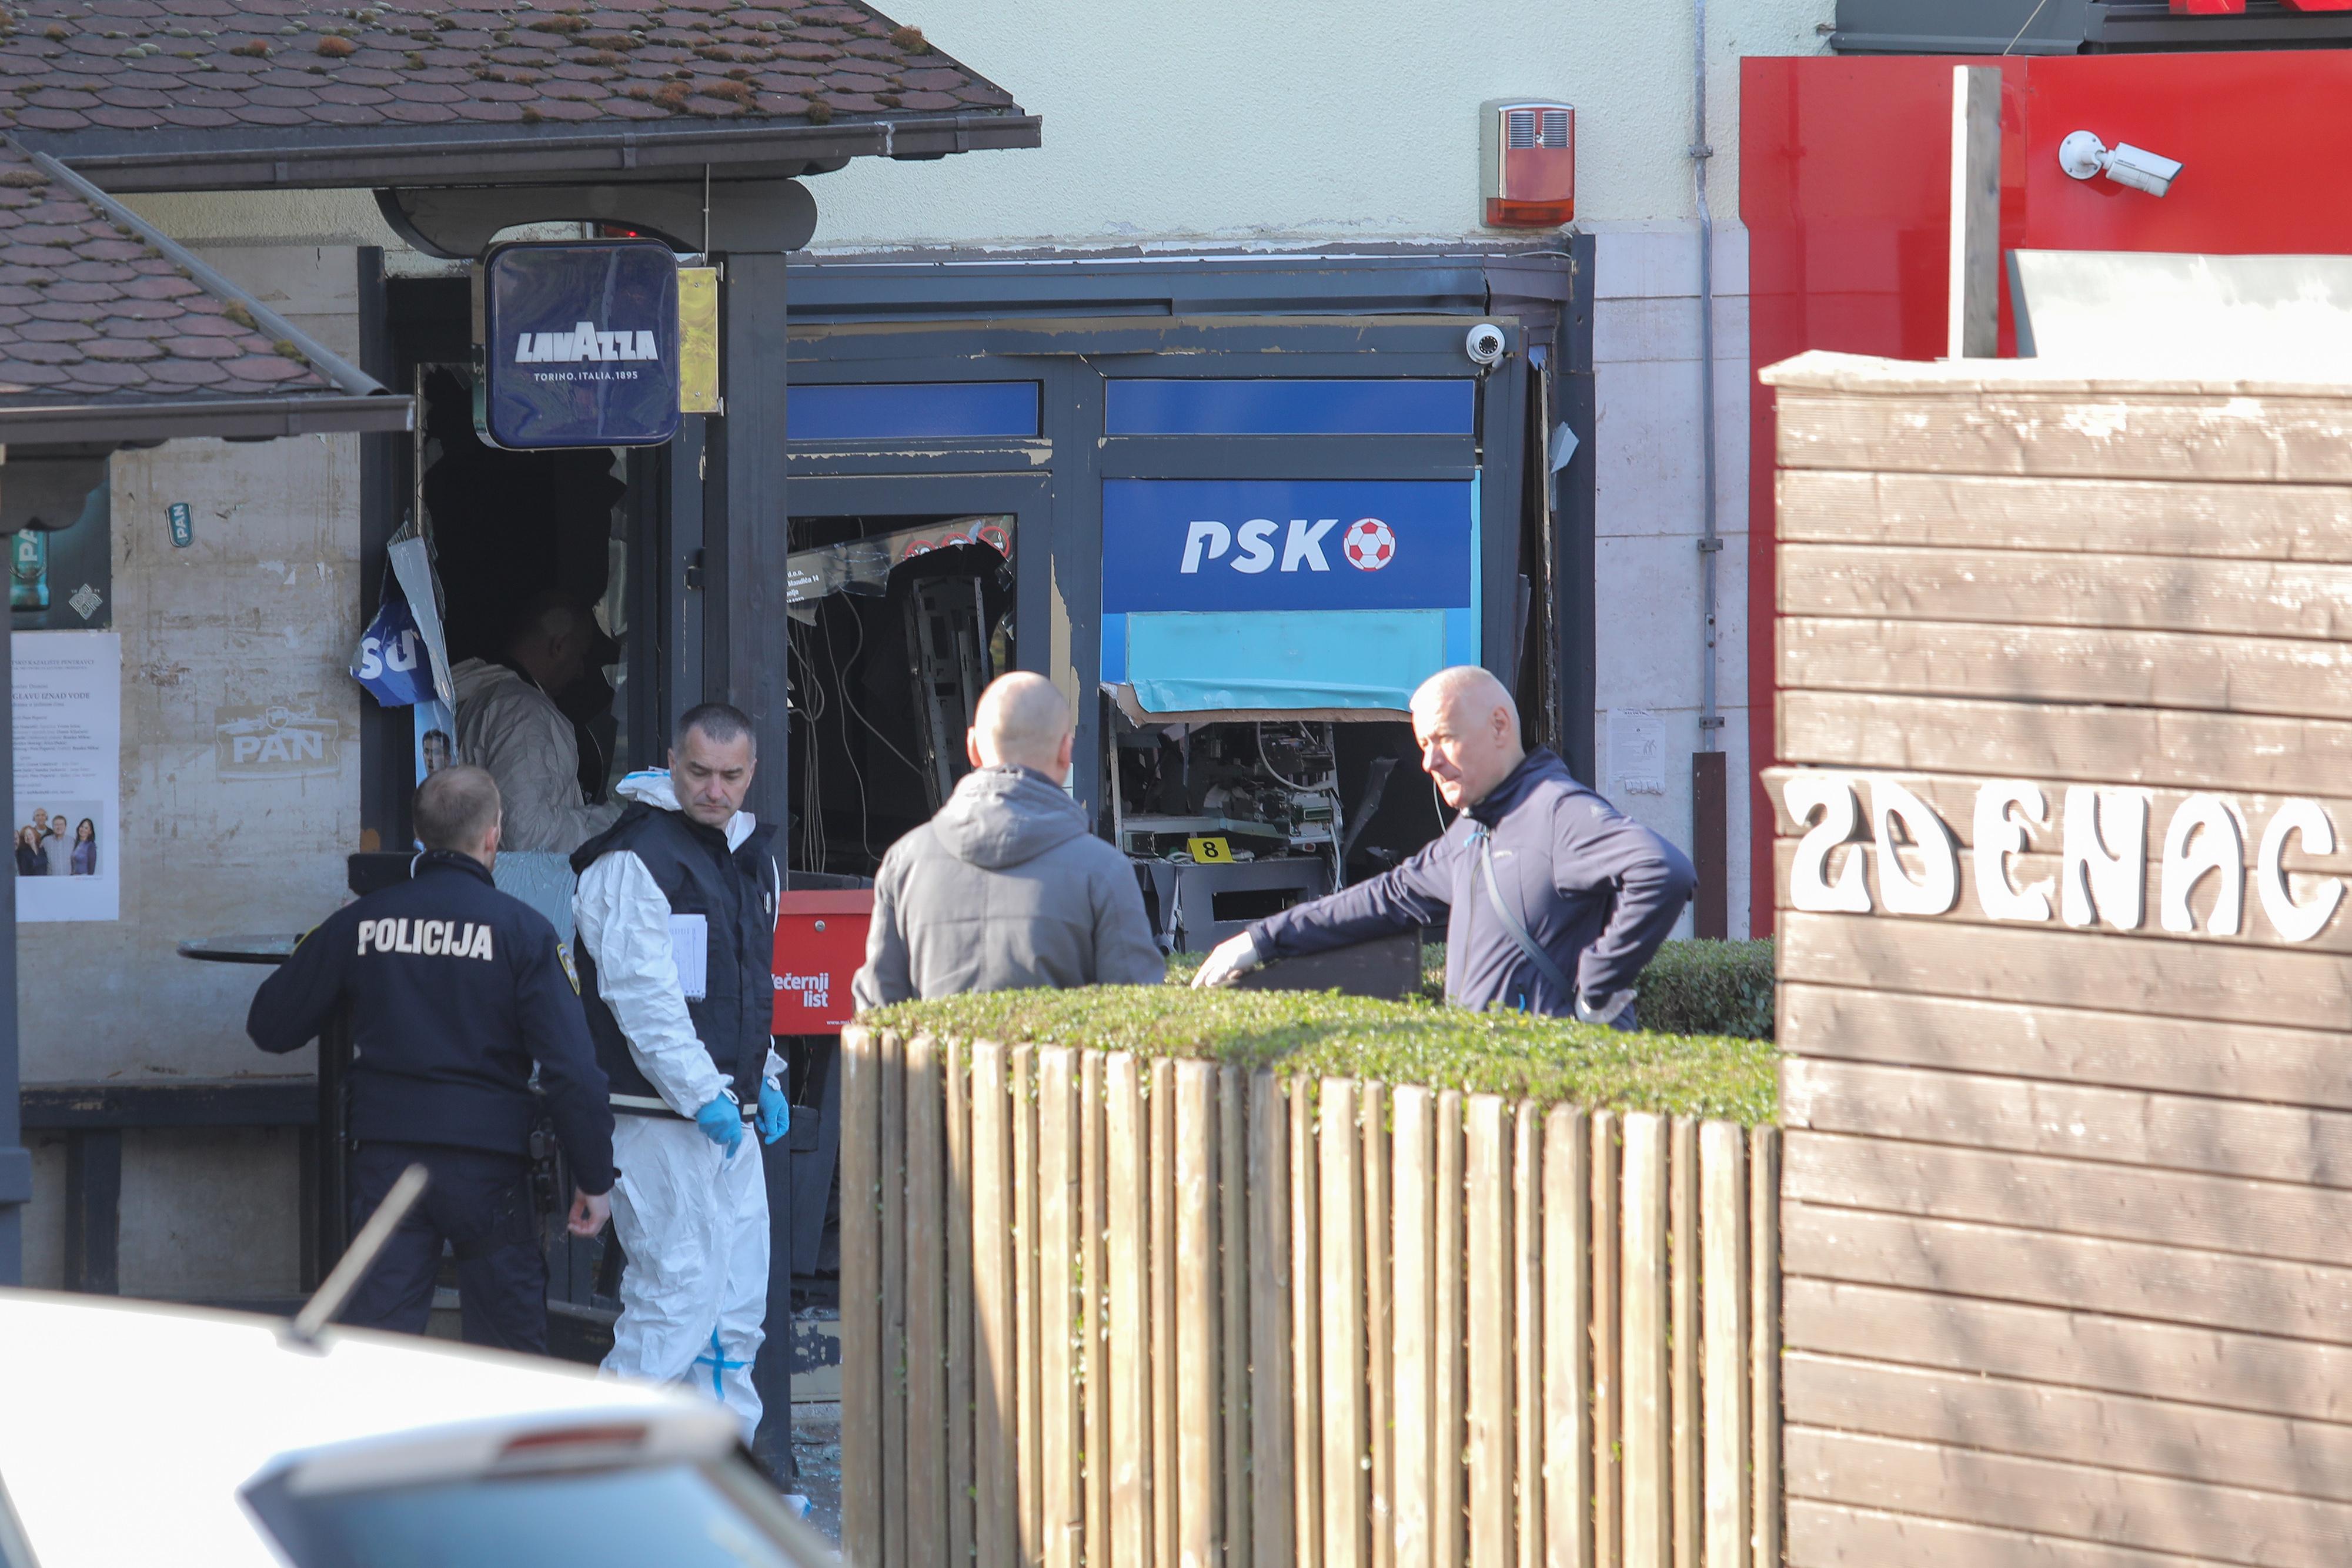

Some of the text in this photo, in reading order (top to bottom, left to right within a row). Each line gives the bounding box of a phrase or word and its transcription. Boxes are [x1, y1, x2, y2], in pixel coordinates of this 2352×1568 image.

[515, 322, 659, 363] LAVAZZA
[615, 370, 637, 380] 1895
[173, 505, 188, 539] PAN
[1180, 518, 1339, 574] PSK
[233, 731, 323, 763] PAN
[1203, 841, 1218, 857] 8
[1783, 779, 2345, 941] ZDENAC
[358, 917, 493, 961] POLICIJA
[803, 990, 828, 1007] list
